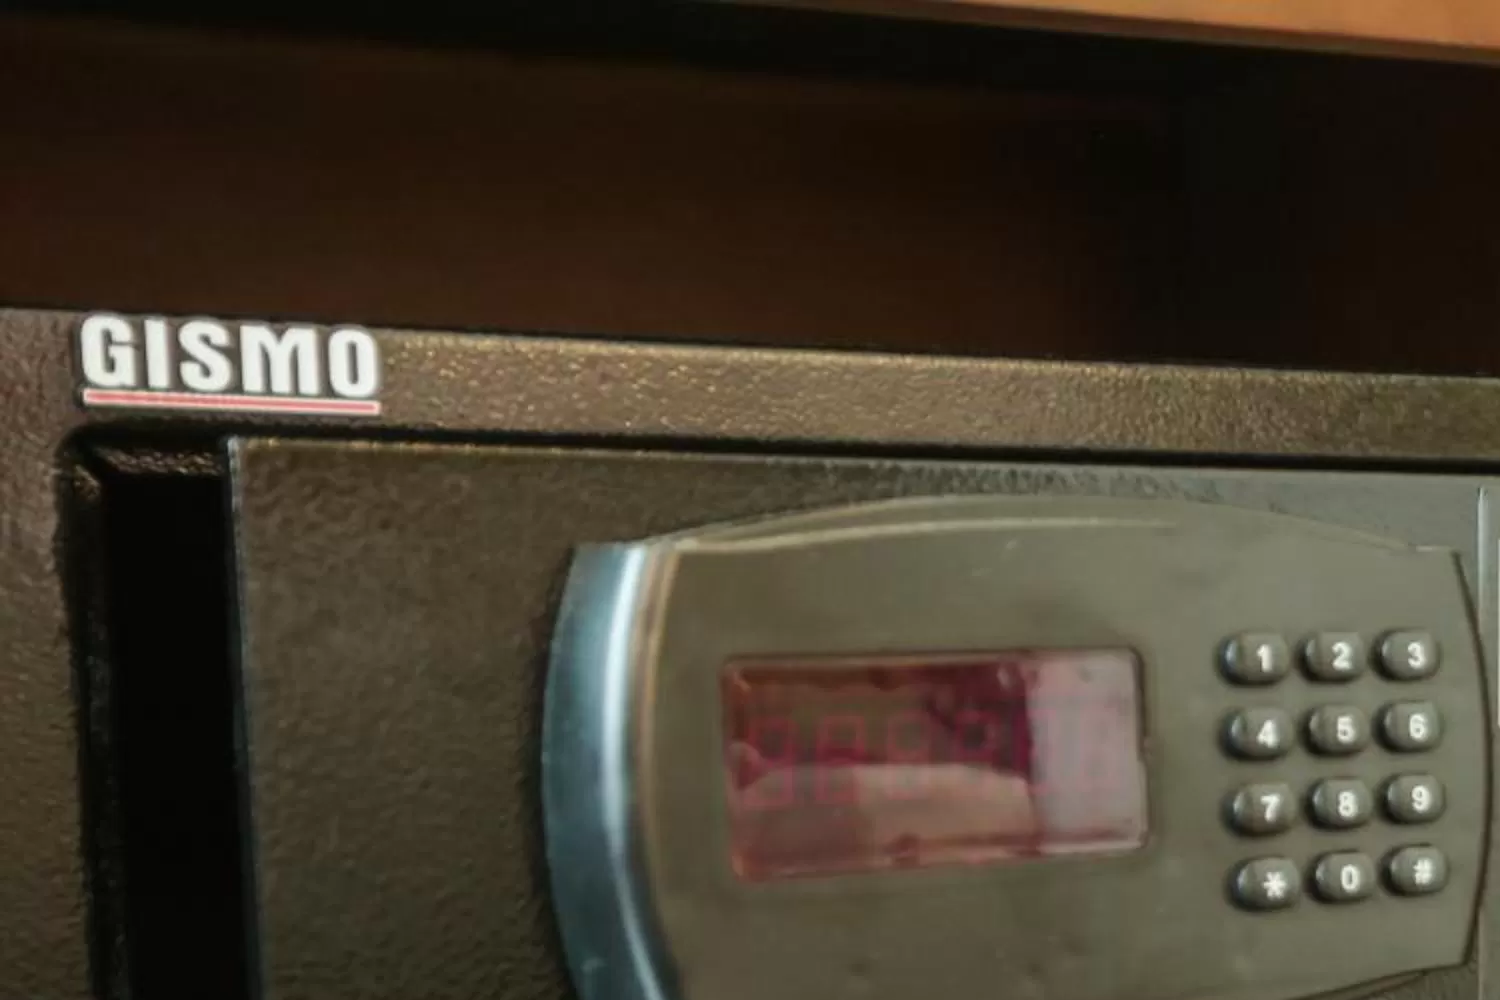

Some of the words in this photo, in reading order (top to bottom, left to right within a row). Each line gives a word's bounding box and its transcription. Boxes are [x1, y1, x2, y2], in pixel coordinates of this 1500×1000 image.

[80, 312, 380, 399] GISMO
[1257, 643, 1273, 672] 1
[1332, 641, 1352, 671] 2
[1407, 641, 1427, 669] 3
[1256, 719, 1278, 748] 4
[1336, 715, 1355, 744] 5
[1408, 713, 1428, 741] 6
[1260, 793, 1281, 822] 7
[1337, 791, 1358, 818] 8
[1411, 784, 1431, 812] 9
[1340, 863, 1361, 893] 0
